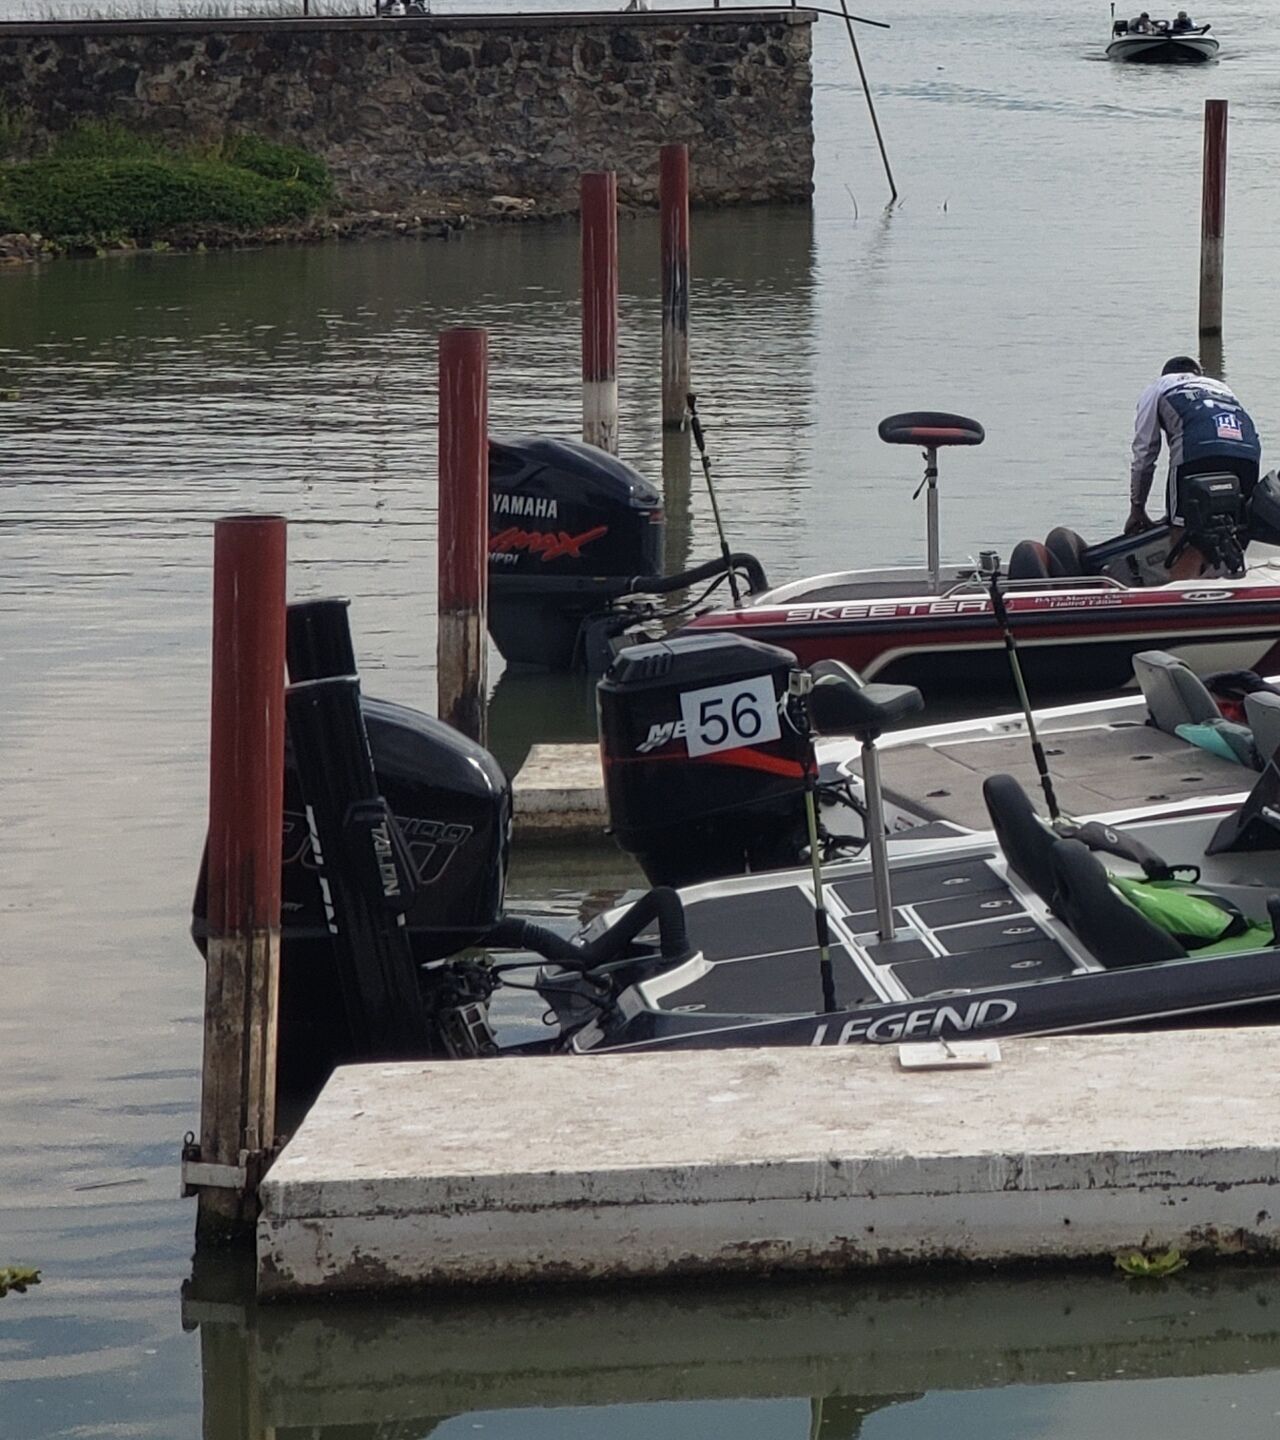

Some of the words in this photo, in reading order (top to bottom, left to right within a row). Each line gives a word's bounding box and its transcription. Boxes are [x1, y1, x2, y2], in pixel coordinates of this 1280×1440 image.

[492, 493, 558, 519] YAMAHA
[786, 601, 988, 622] SKEETER
[700, 692, 761, 745] 56
[811, 999, 1017, 1046] LEGEND
